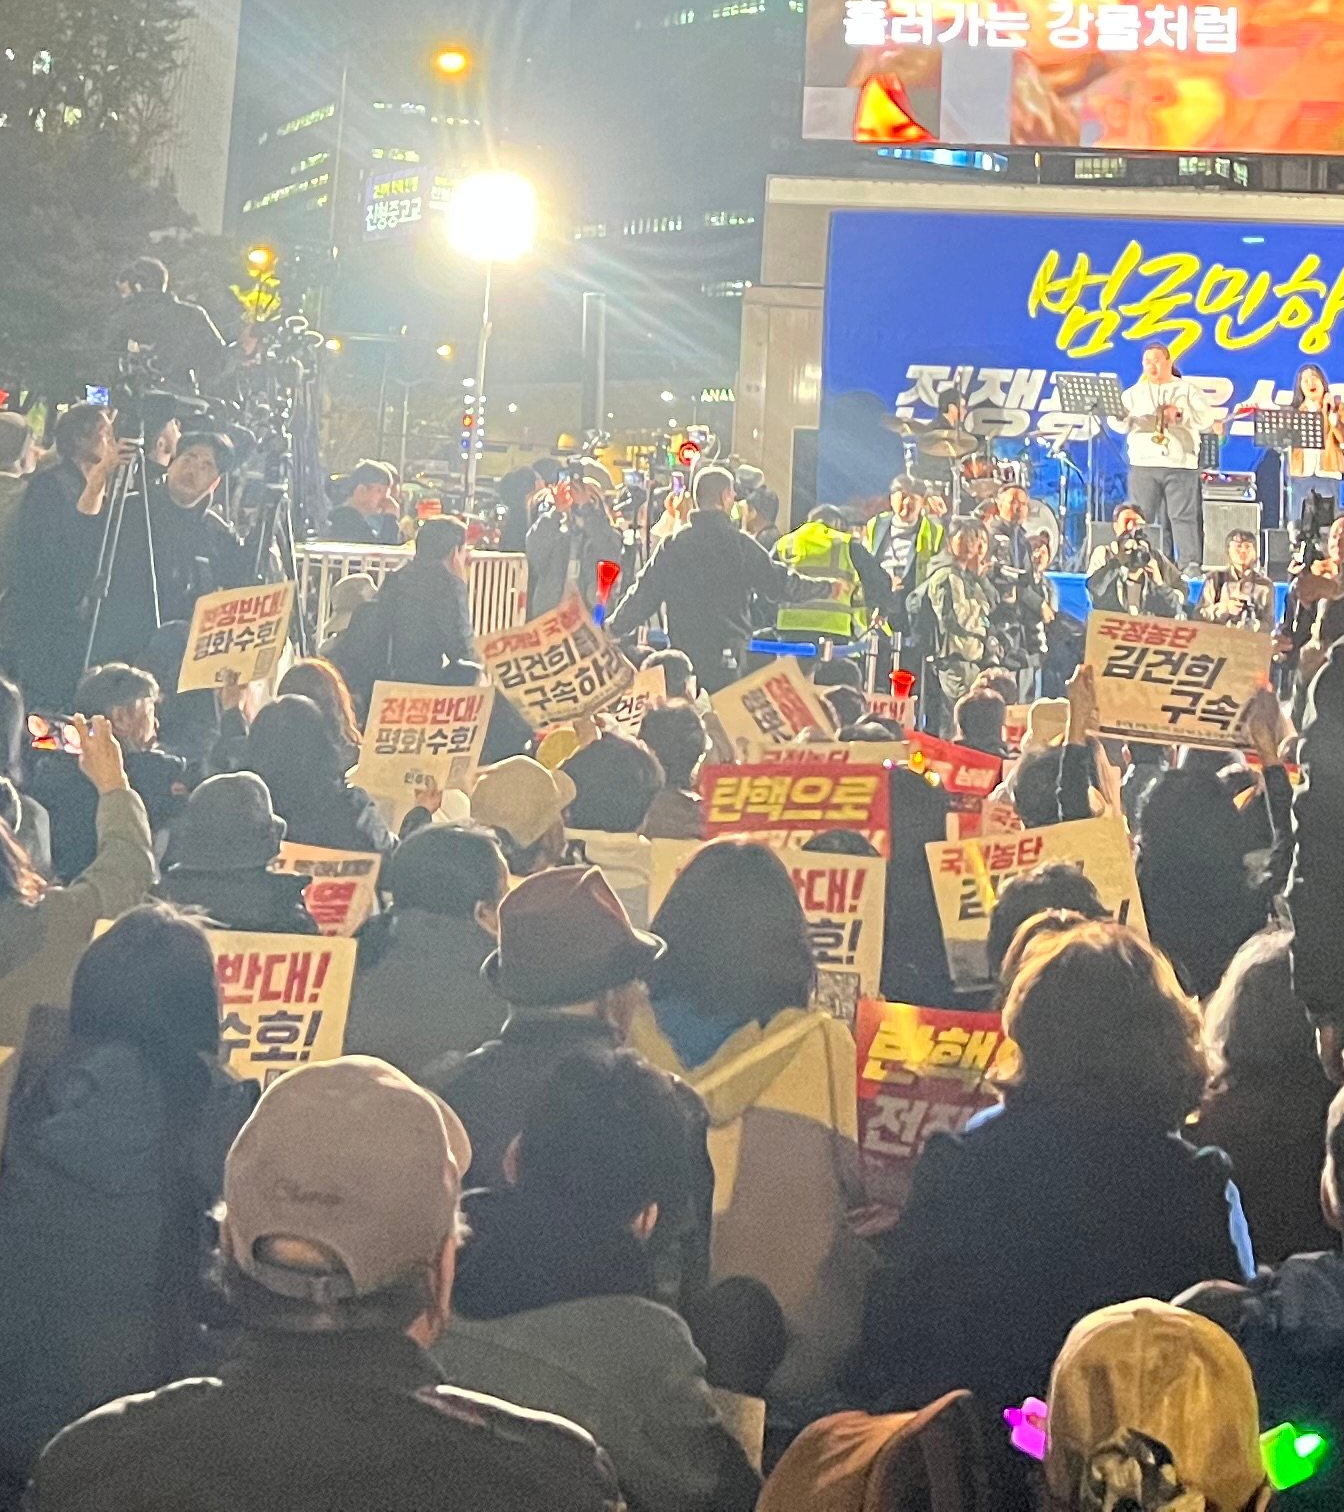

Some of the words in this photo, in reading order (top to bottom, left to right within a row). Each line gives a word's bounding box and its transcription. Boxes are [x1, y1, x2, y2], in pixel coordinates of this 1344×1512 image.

[1046, 0, 1239, 54] 강물처럼
[1098, 617, 1199, 649] 국정농단
[1103, 644, 1228, 690] 김건희
[379, 694, 485, 726] 전쟁반대!
[374, 725, 479, 756] 평화수호!
[708, 775, 879, 823] 탄핵으로
[215, 950, 333, 1005] 반대!
[216, 1008, 323, 1064] 수호!
